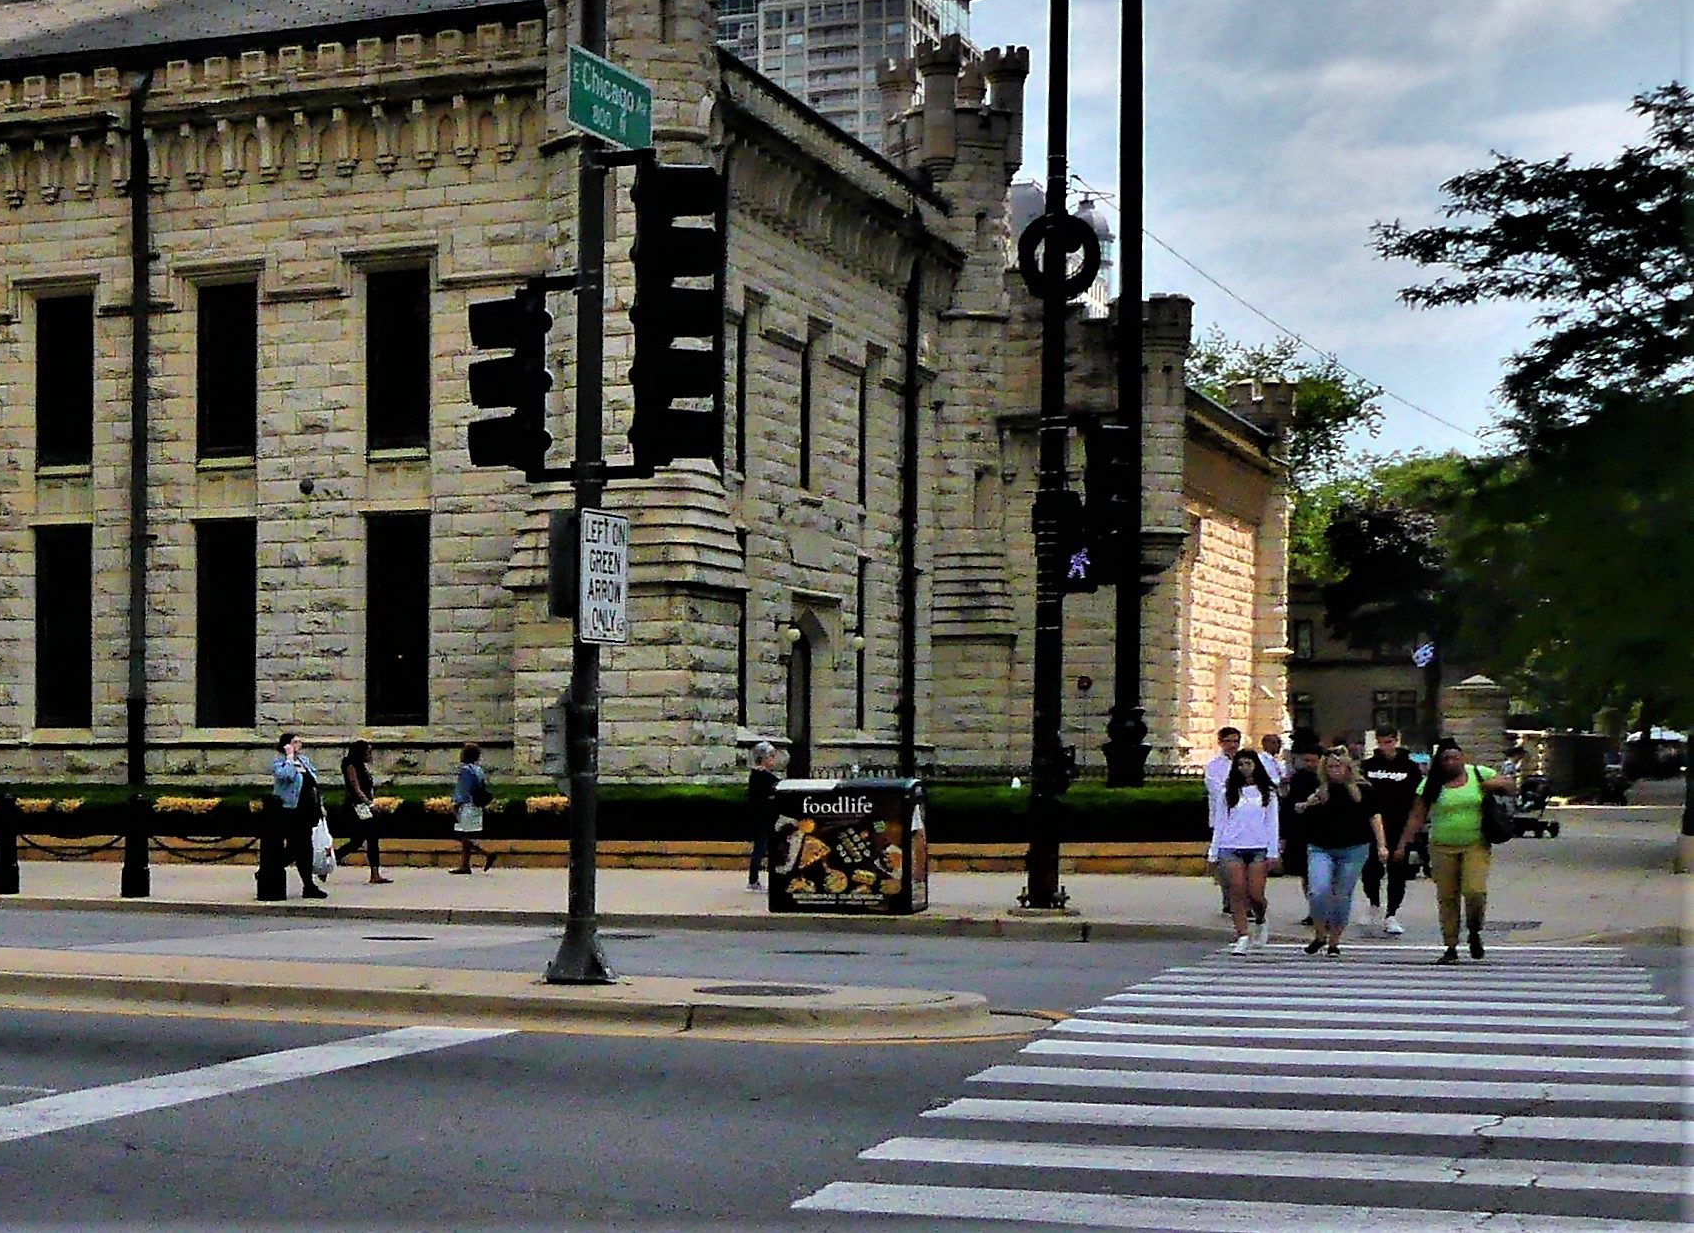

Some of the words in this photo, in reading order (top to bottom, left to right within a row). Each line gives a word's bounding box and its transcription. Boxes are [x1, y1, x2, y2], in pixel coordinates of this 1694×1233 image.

[573, 62, 580, 82] E
[583, 61, 634, 118] Chicago
[585, 517, 609, 544] LEFT
[612, 522, 626, 546] ON
[589, 549, 621, 576] GREEN
[587, 577, 621, 604] ARROW
[592, 607, 617, 632] ONLY
[802, 795, 873, 814] foodlife
